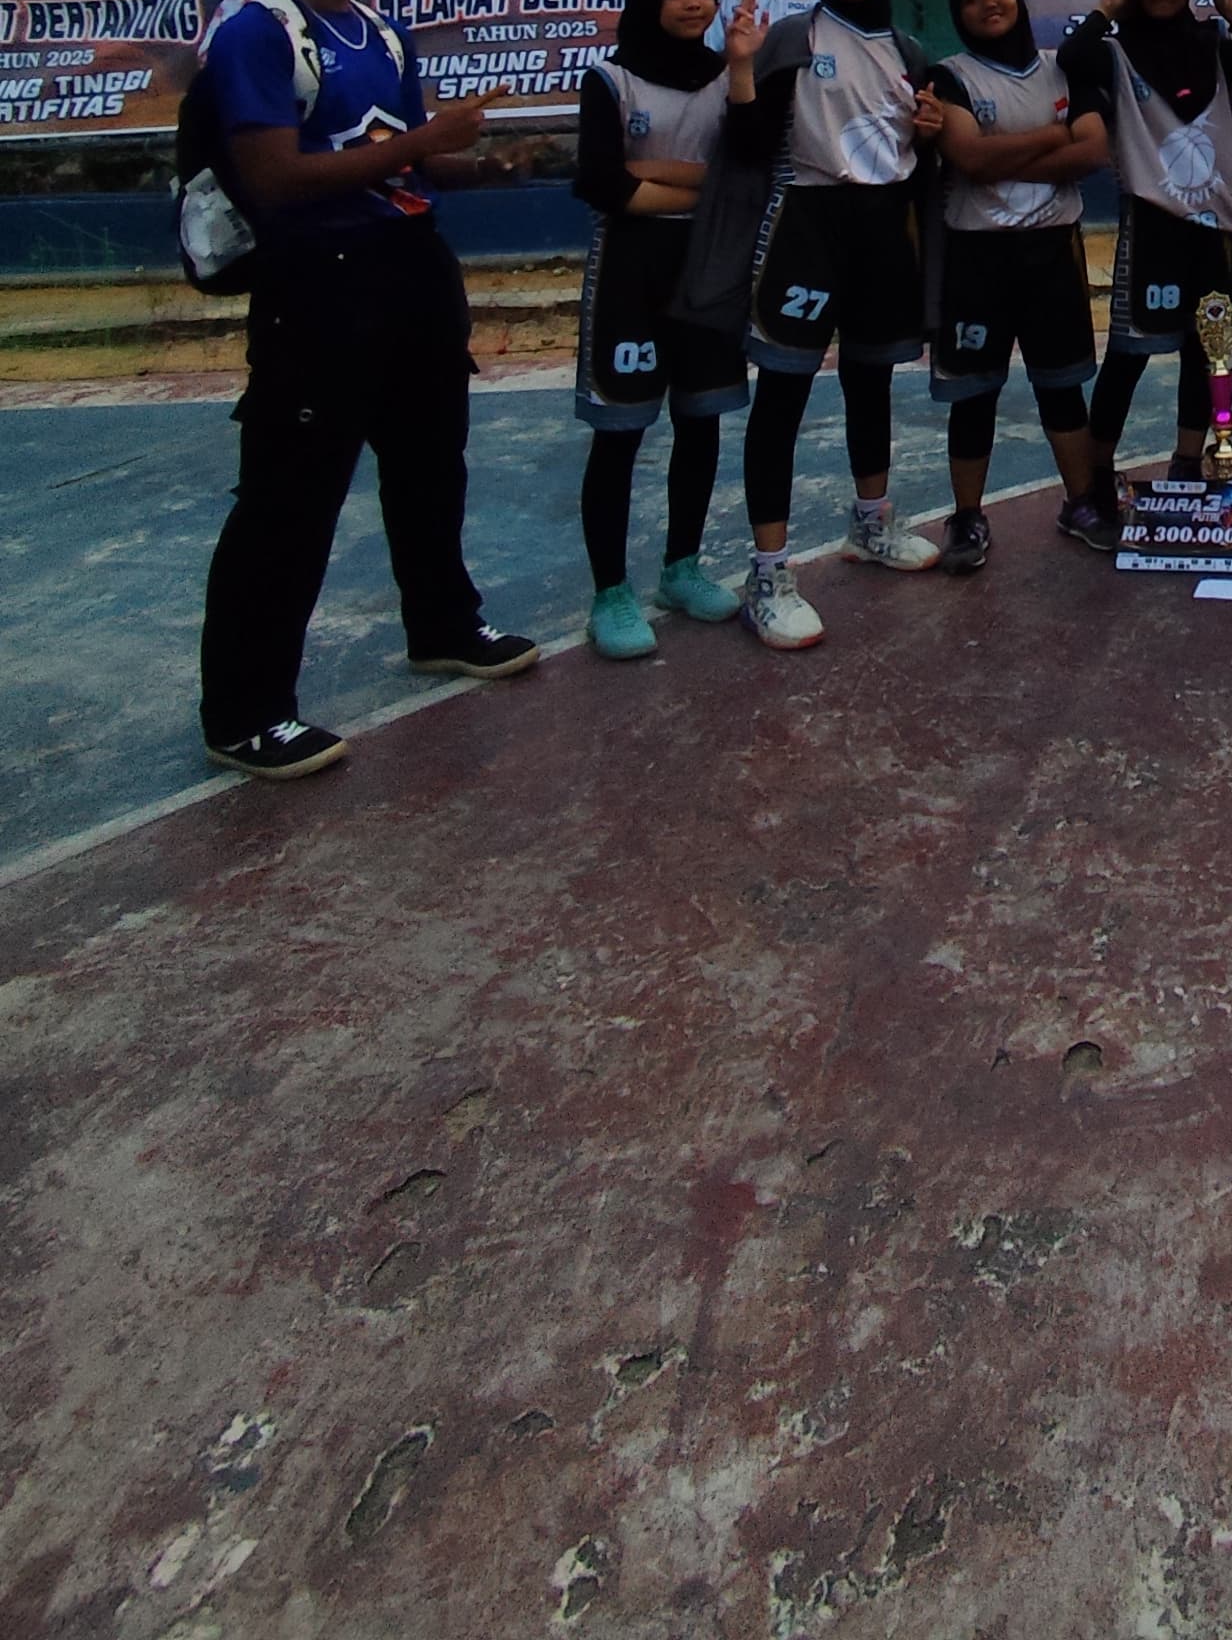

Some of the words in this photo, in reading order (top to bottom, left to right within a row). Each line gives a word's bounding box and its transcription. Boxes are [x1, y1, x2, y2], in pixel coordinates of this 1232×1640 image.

[463, 23, 538, 43] TAHUN
[545, 21, 598, 39] 2025
[46, 49, 95, 67] 2025
[417, 49, 548, 78] JUNJUNG
[56, 69, 153, 96] TINGGI
[780, 285, 831, 322] 27
[1145, 282, 1182, 310] 08
[613, 339, 657, 374] 03
[1137, 496, 1202, 512] JUARA
[1202, 493, 1222, 512] 3
[1121, 525, 1151, 542] RP.
